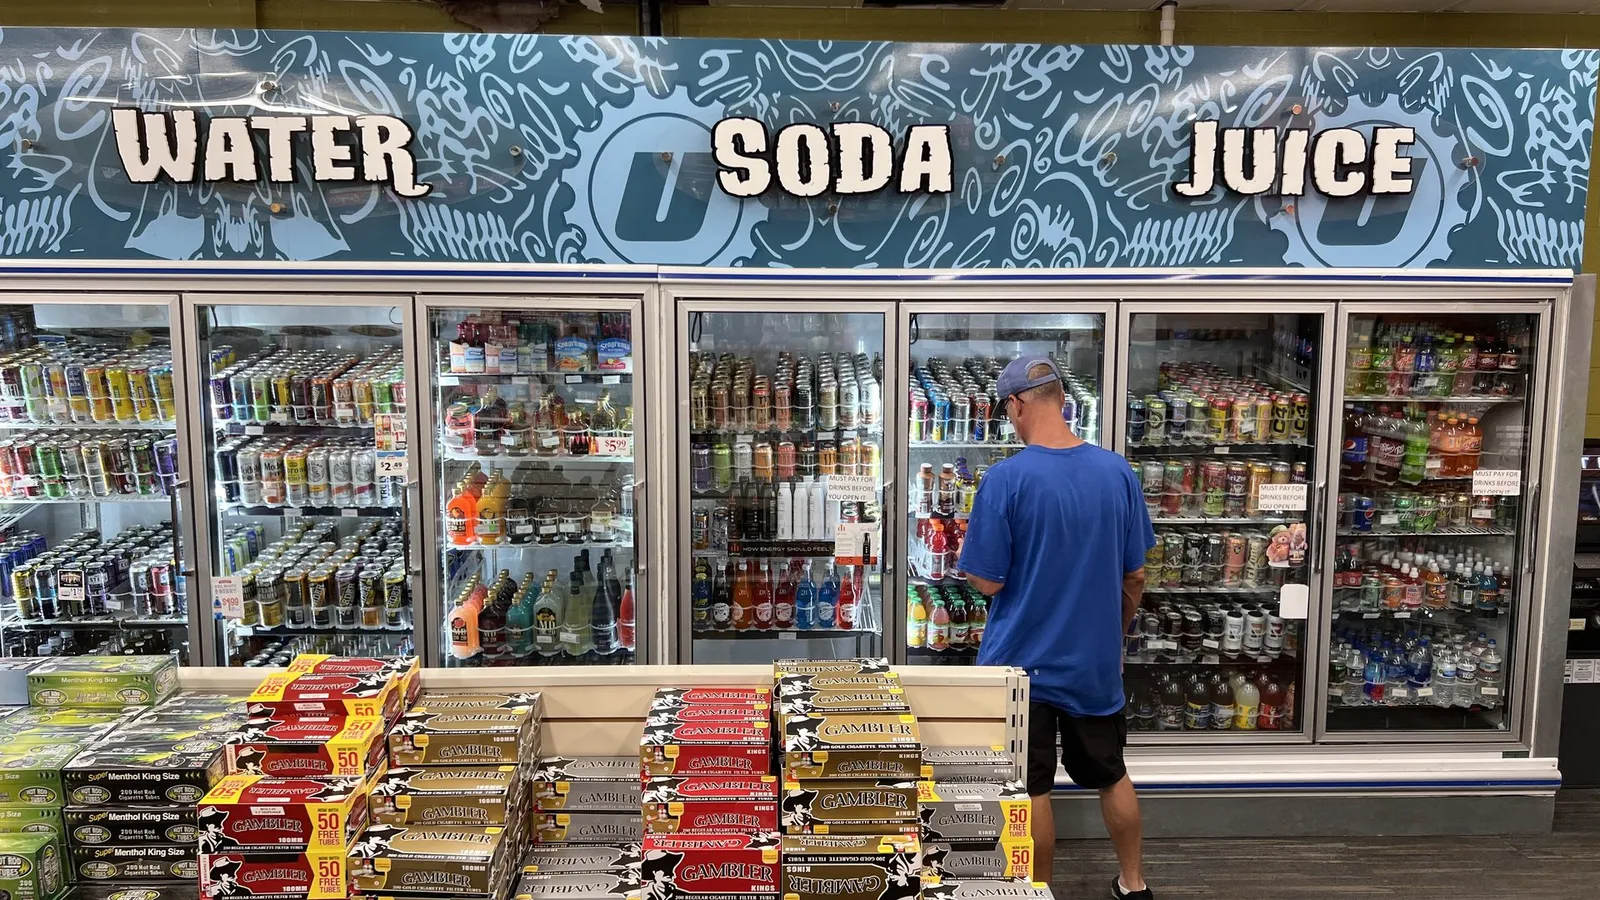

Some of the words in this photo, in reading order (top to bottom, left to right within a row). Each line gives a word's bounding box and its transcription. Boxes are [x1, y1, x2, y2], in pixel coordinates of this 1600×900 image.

[112, 107, 432, 197] WATER
[712, 116, 954, 197] SODA
[1175, 120, 1415, 198] JUICE
[816, 677, 896, 685] GAMBLER
[688, 693, 765, 701] GAMBLER
[818, 694, 901, 704] GAMBLER
[436, 714, 519, 723] GAMBLER
[684, 709, 764, 718] GAMBLER
[347, 722, 374, 731] 50
[680, 728, 764, 737] GAMBLER
[825, 723, 912, 736] GAMBLER
[439, 744, 502, 758] GAMBLER
[928, 750, 1003, 758] GAMBLER
[267, 758, 328, 772] GAMBLER
[338, 752, 359, 768] 50
[689, 757, 752, 770] GAMBLER
[837, 760, 905, 773] GAMBLER
[88, 771, 109, 782] Super
[142, 773, 161, 782] King
[419, 771, 506, 781] GAMBLER
[684, 782, 772, 792] GAMBLER
[579, 793, 638, 804] GAMBLER
[820, 791, 908, 810] GAMBLER
[89, 812, 109, 823] Super
[142, 813, 161, 822] King
[422, 806, 488, 820] GAMBLER
[938, 813, 996, 826] GAMBLER
[1009, 808, 1028, 823] 50
[232, 818, 303, 833] GAMBLER
[318, 813, 339, 830] 50
[694, 813, 761, 827] GAMBLER
[318, 831, 340, 839] FREE
[579, 825, 638, 836] GAMBLER
[401, 832, 492, 844] GAMBLER
[95, 847, 115, 858] Super
[114, 849, 146, 857] Menthol
[148, 849, 166, 858] King
[1012, 850, 1030, 865] 50
[319, 861, 340, 877] 50
[950, 857, 1002, 868] GAMBLER
[243, 867, 307, 882] GAMBLER
[402, 872, 471, 887] GAMBLER
[681, 863, 773, 883] GAMBLER
[319, 878, 341, 886] FREE
[789, 875, 881, 895] GAMBLER
[961, 888, 1048, 897] GAMBLER
